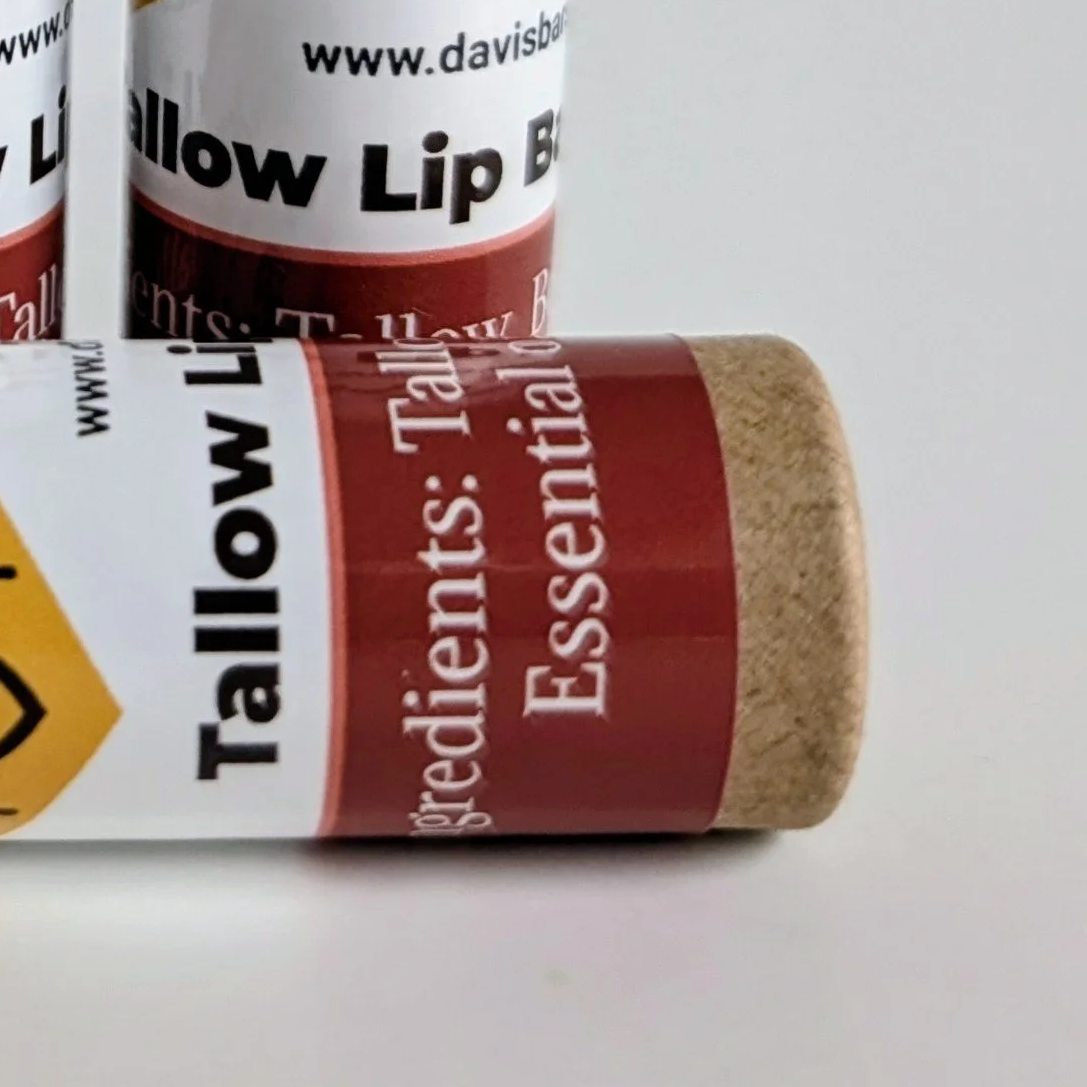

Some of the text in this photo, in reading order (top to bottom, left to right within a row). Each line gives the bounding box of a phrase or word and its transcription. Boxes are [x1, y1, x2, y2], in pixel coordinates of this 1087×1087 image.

[30, 83, 69, 185] Li
[360, 130, 504, 225] Lip
[167, 338, 282, 782] Tallow Li
[498, 363, 611, 721] Essential
